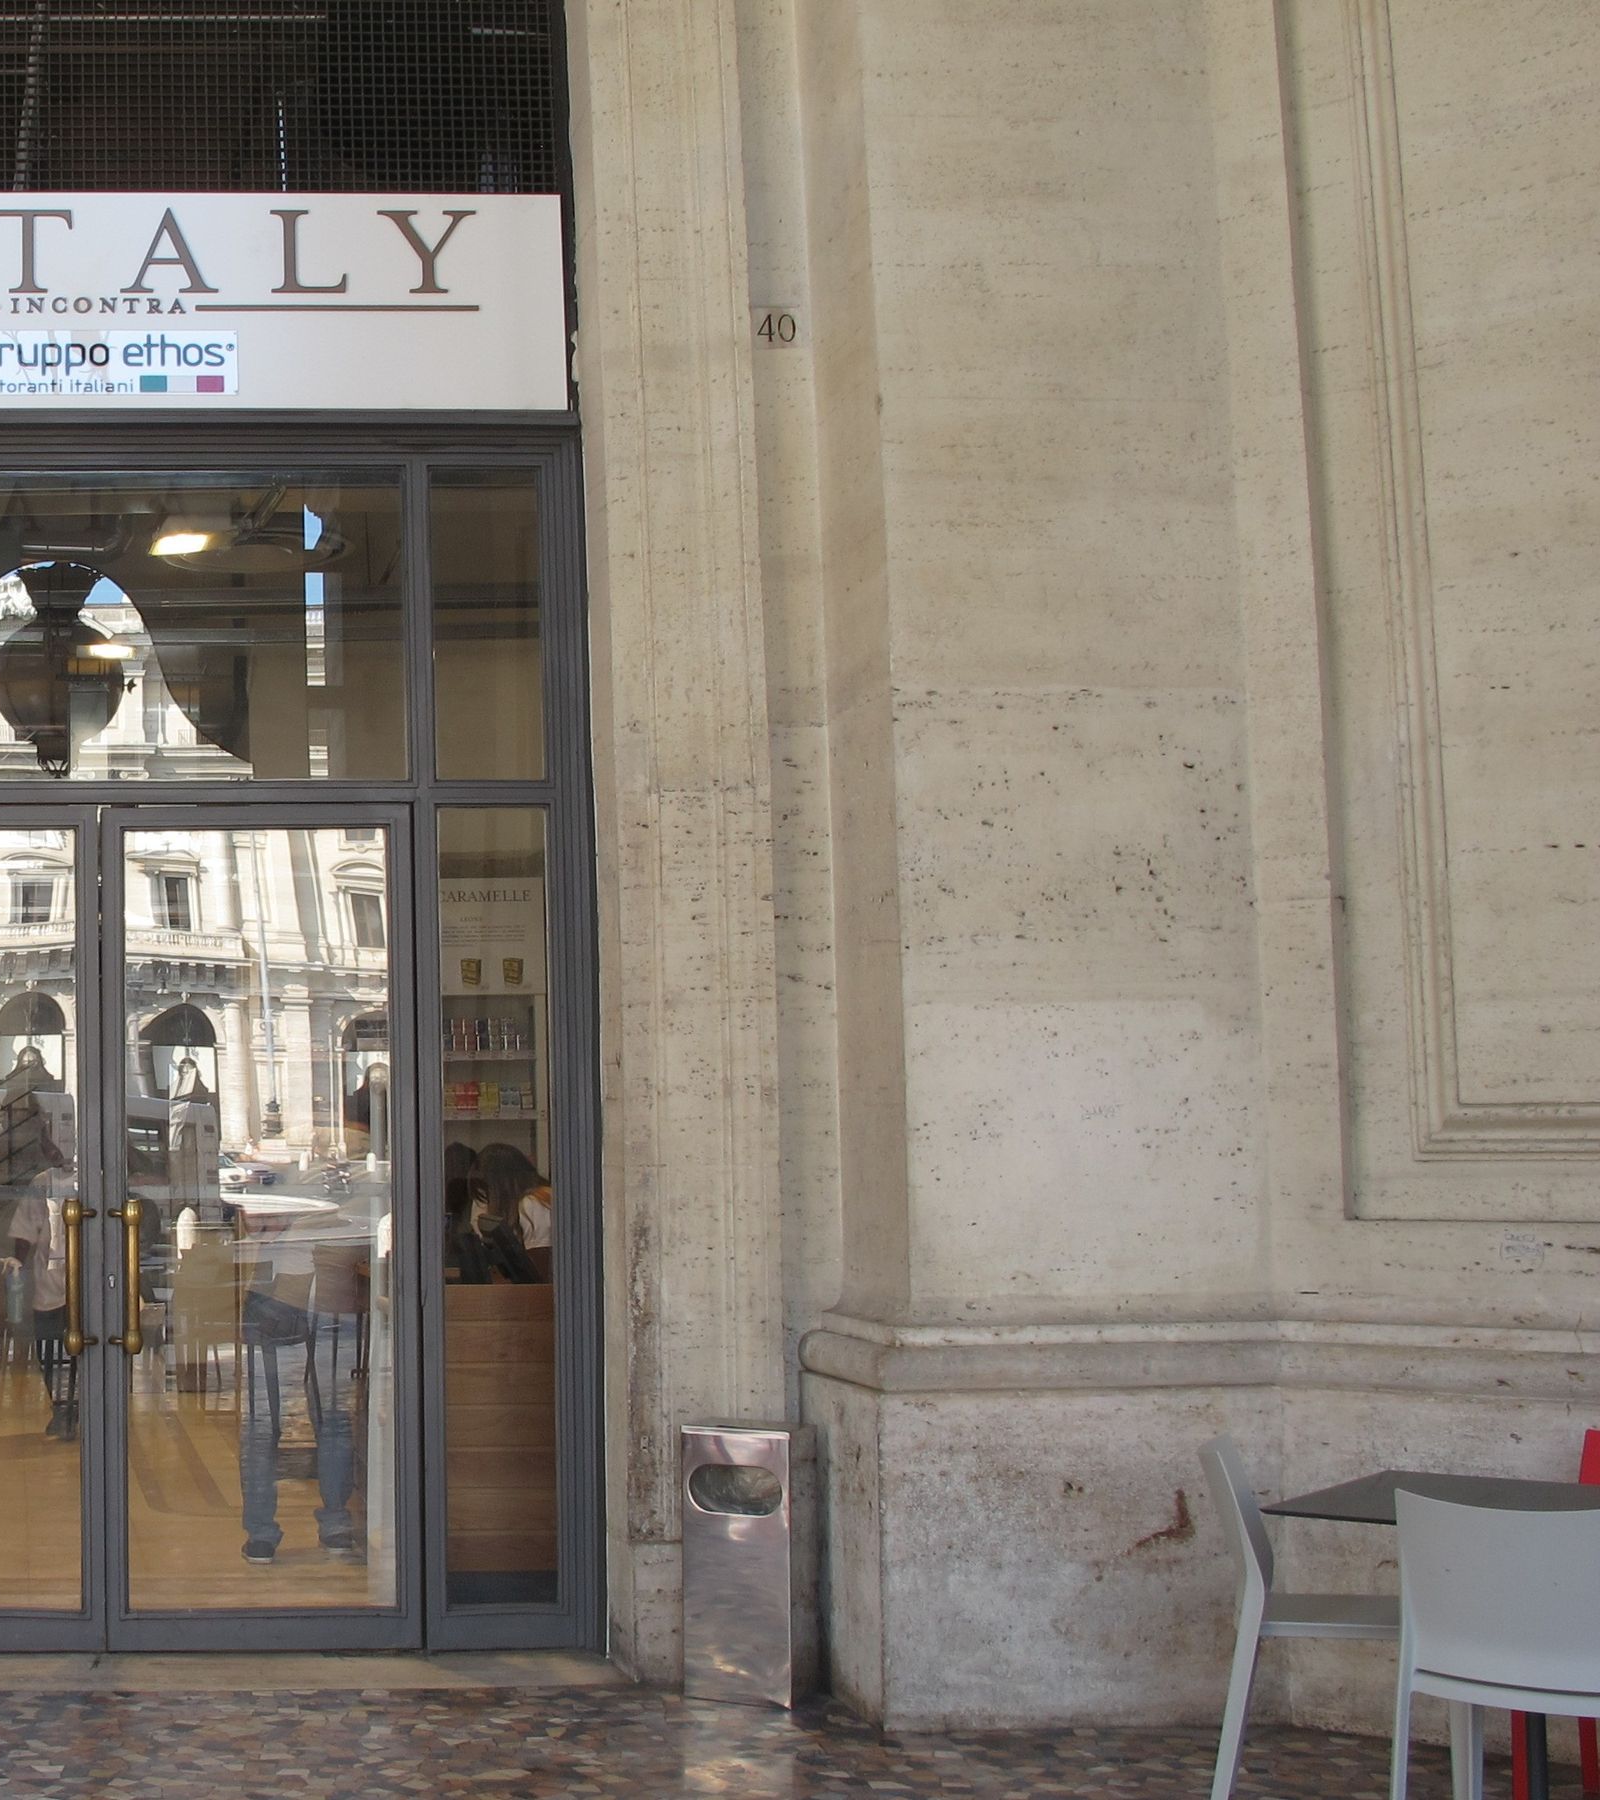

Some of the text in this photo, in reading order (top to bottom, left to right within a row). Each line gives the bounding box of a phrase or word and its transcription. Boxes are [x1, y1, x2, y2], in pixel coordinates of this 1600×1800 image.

[10, 297, 187, 314] INCONTRA
[757, 313, 796, 342] 40
[69, 378, 134, 393] italiani
